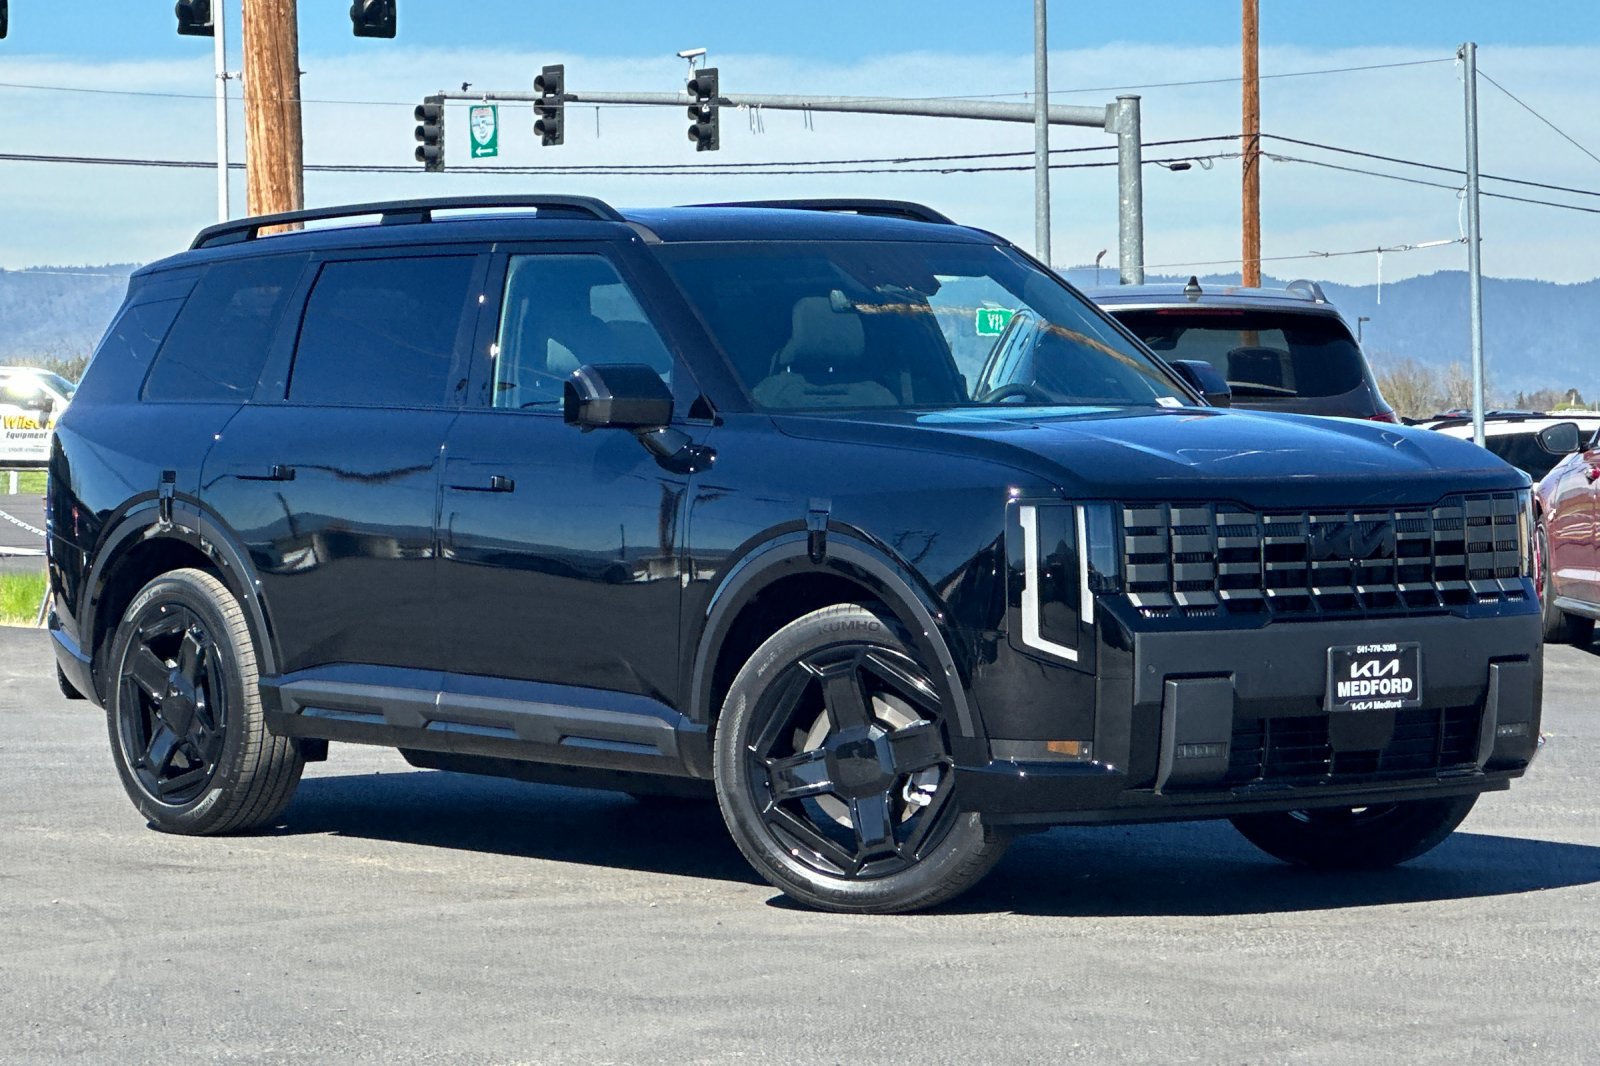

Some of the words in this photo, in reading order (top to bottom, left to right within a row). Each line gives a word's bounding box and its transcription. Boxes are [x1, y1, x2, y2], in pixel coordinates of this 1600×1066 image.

[6, 431, 48, 440] Equipment
[1350, 658, 1400, 679] KIA
[1337, 677, 1413, 698] MEDFORD
[1373, 699, 1402, 711] Medford
